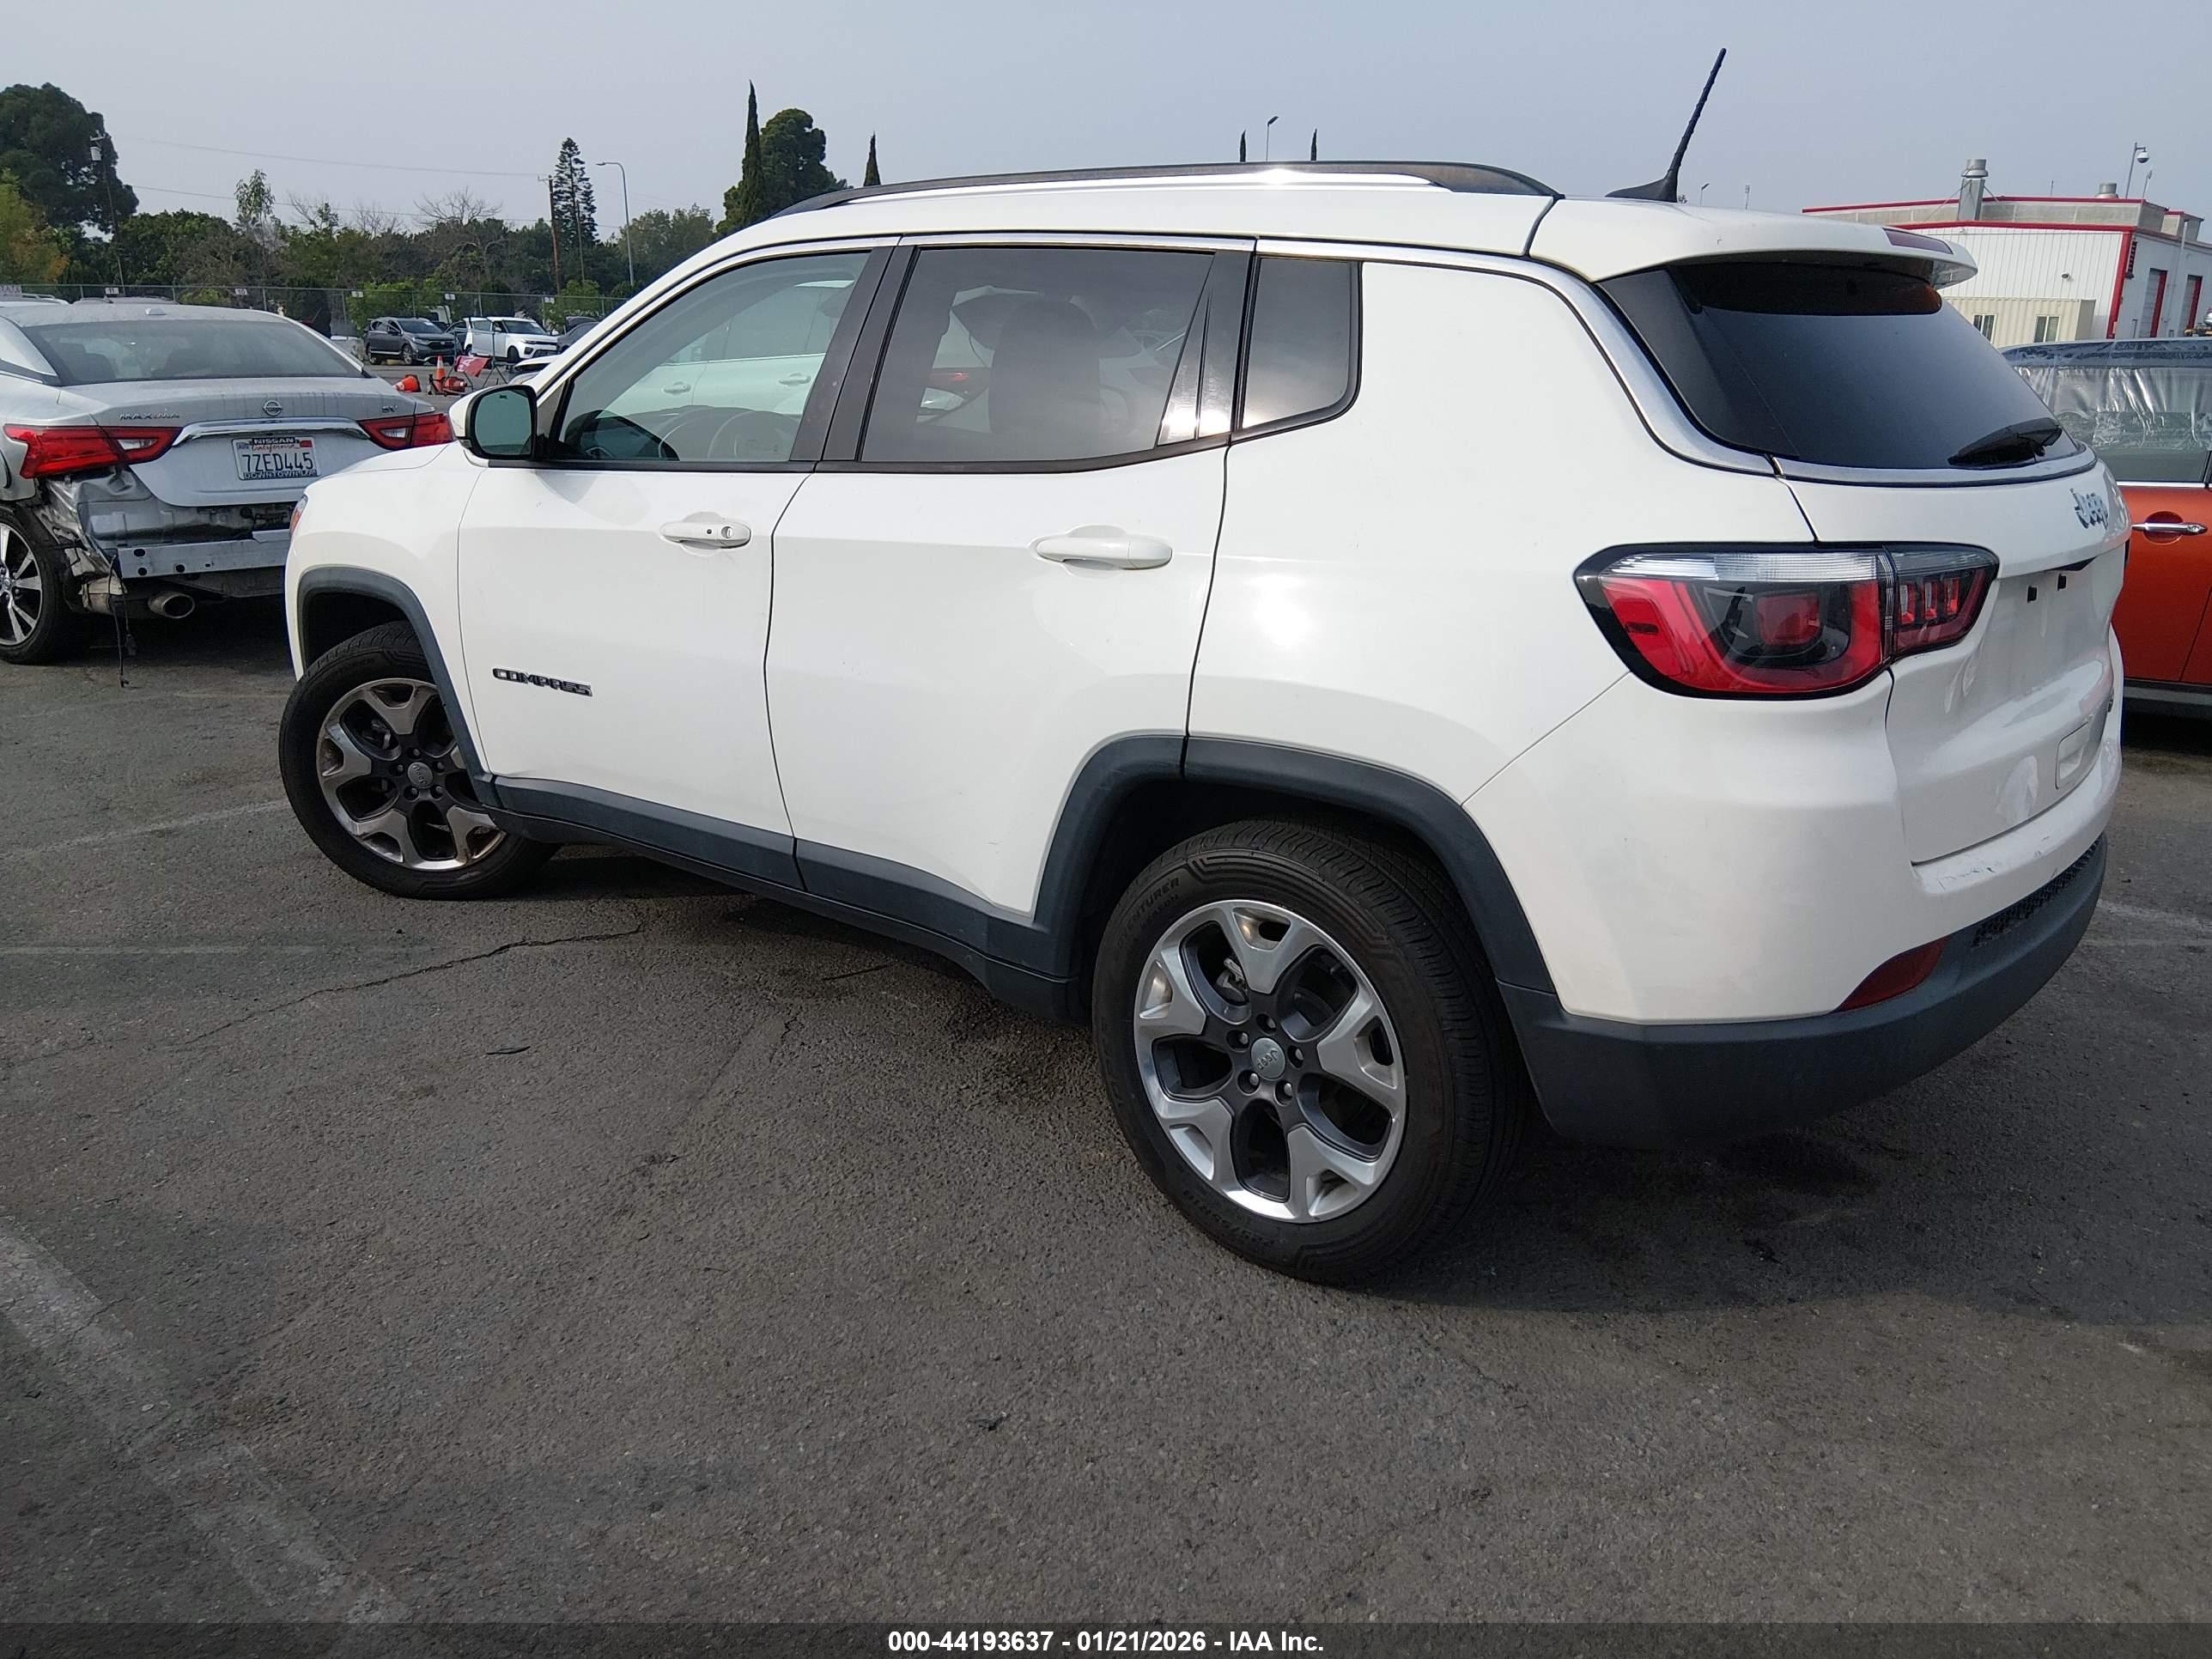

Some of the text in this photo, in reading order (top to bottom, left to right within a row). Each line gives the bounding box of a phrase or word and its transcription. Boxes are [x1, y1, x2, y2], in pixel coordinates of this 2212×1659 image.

[242, 452, 313, 471] 7ZED445
[244, 471, 298, 479] DOWNTOWN
[2069, 488, 2109, 531] Jeep
[492, 668, 593, 697] COMPASS
[1256, 1048, 1278, 1070] Jeep
